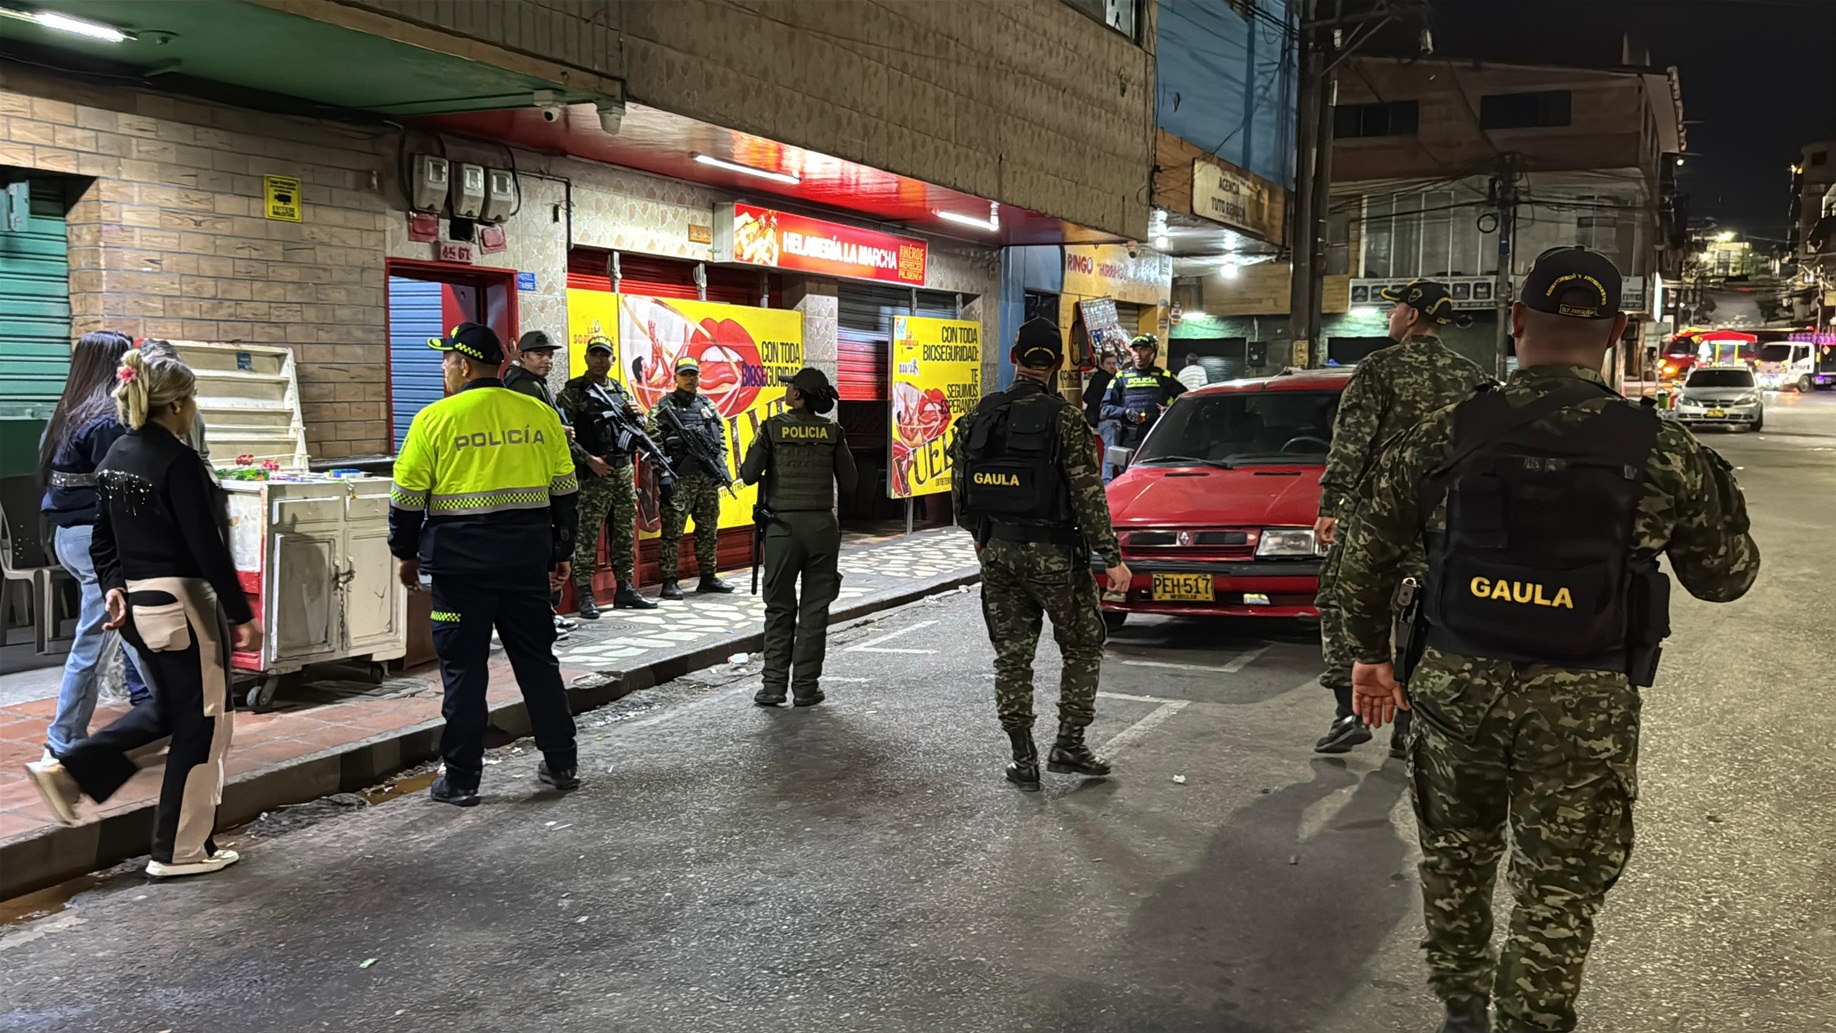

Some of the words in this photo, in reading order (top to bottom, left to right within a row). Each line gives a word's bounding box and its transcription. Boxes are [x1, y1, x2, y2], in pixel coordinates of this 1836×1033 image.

[843, 242, 858, 264] LA
[858, 245, 898, 270] MARCHA
[1067, 253, 1094, 275] RINGO
[941, 326, 958, 344] CON
[959, 327, 978, 344] TODA
[761, 340, 779, 363] CON
[780, 342, 801, 364] TODA
[970, 368, 979, 383] TE
[946, 383, 979, 399] SEGUIMOS
[453, 423, 545, 451] POLICÍA
[781, 426, 829, 440] POLICIA
[973, 472, 1020, 487] GAULA
[1470, 576, 1574, 609] GAULA
